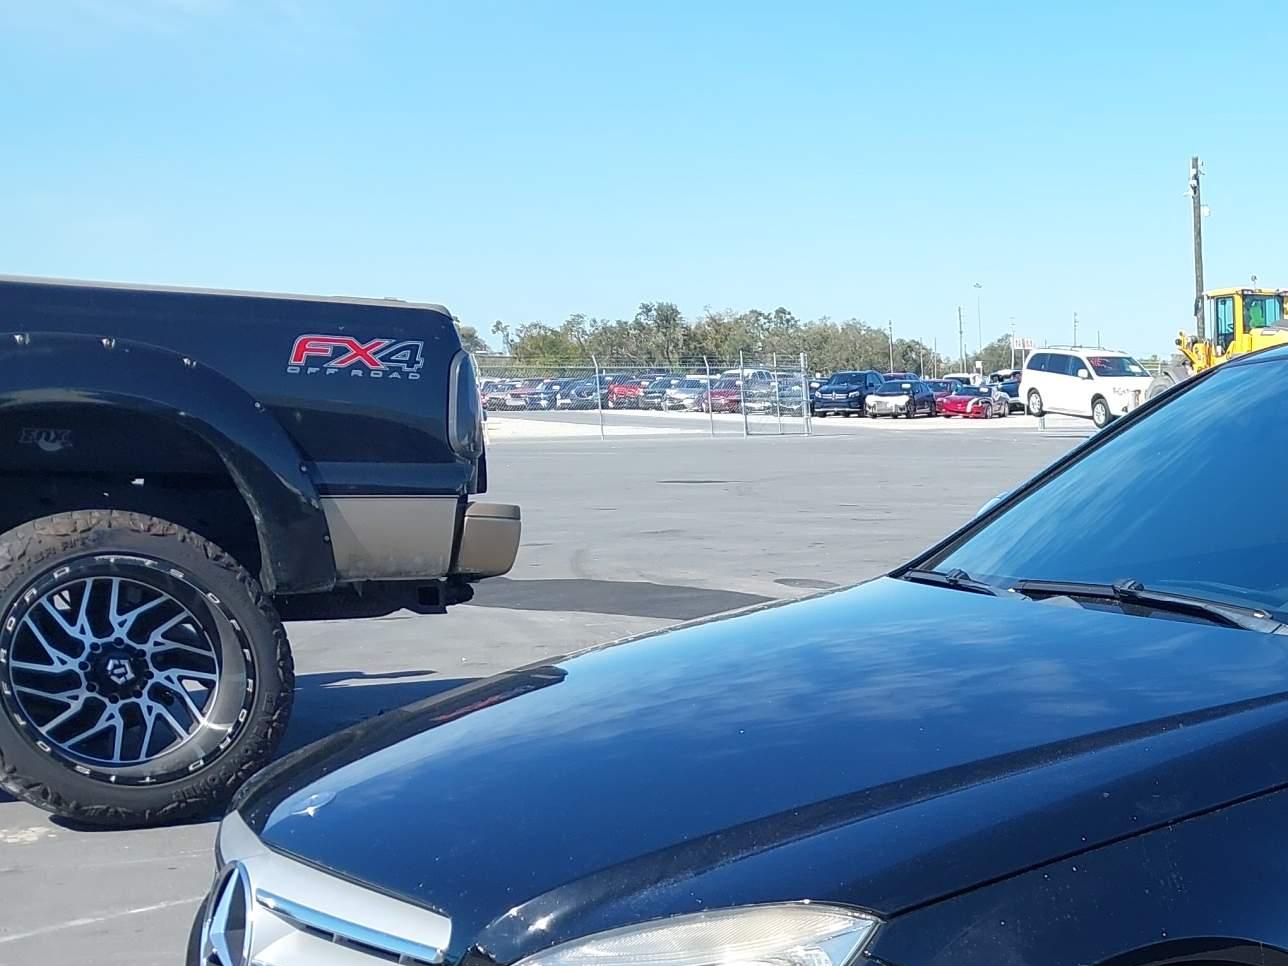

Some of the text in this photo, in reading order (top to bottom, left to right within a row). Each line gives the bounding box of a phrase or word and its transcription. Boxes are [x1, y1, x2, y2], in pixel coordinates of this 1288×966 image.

[288, 333, 424, 372] FX4
[286, 366, 421, 380] OFF ROAD
